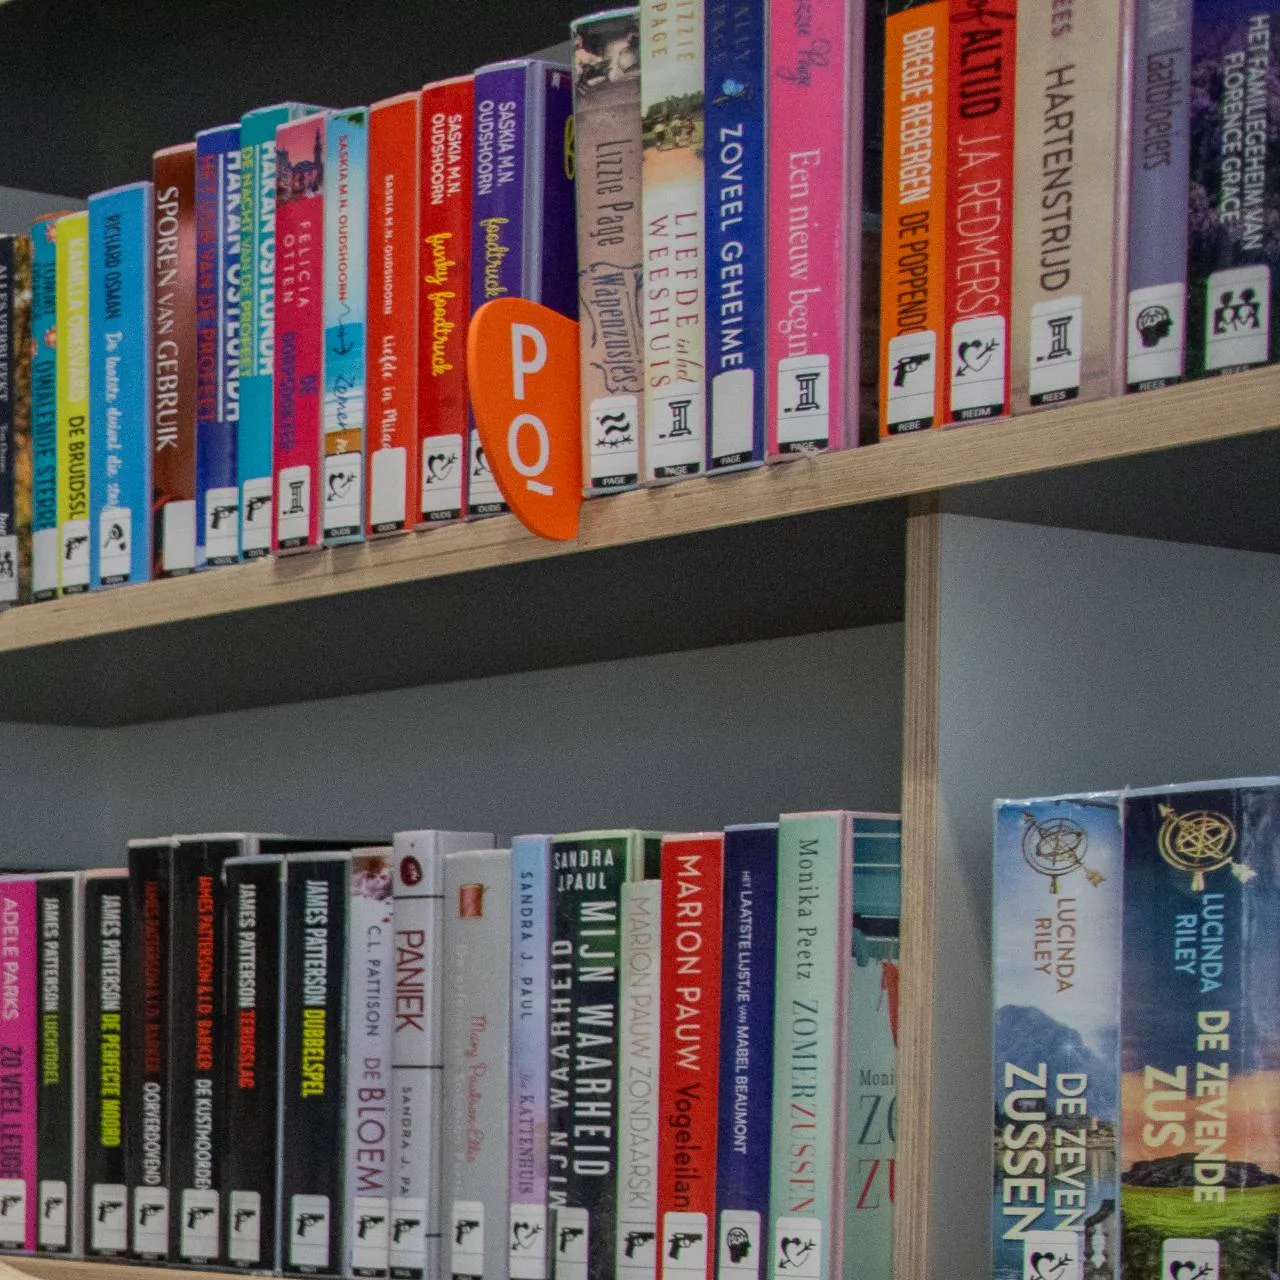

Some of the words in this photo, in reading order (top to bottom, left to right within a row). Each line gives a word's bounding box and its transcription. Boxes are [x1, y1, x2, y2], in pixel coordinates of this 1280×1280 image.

[901, 26, 934, 101] BREGJE
[959, 26, 1002, 120] ALTIJD
[1221, 51, 1245, 146] FLORENCE
[430, 113, 444, 205] OUDSHOORN
[446, 114, 462, 165] SASKIA
[478, 100, 494, 196] OUDSHOORN
[498, 102, 516, 156] SASKIA
[788, 149, 822, 197] Een
[898, 102, 934, 205] REBERGEN
[720, 124, 744, 231] ZOVEEL
[1040, 64, 1076, 292] HARTENSTRIJD
[1219, 148, 1241, 224] GRACE
[157, 186, 180, 288] SPOREN
[675, 211, 700, 329] LIEFDE
[786, 199, 819, 280] nieuw
[898, 211, 929, 238] DE
[157, 294, 176, 334] VAN
[648, 215, 670, 388] WEESHUIS
[155, 340, 179, 452] GEBRUIK
[553, 848, 614, 870] SANDRA
[798, 838, 818, 916] Monika
[579, 901, 615, 982] MIJN
[676, 854, 702, 977] MARION
[797, 926, 817, 979] Peetz
[1033, 917, 1053, 975] RILEY
[1056, 898, 1077, 993] LUCINDA
[1175, 914, 1197, 975] RILEY
[1199, 893, 1225, 994] LUCINDA
[395, 929, 425, 1033] PANIEK
[674, 988, 701, 1072] PAUW
[1197, 1010, 1230, 1052] DE
[573, 1004, 614, 1177] WAARHEID
[1056, 1072, 1088, 1113] DE
[1144, 1065, 1187, 1148] ZUS
[1194, 1062, 1229, 1204] ZEVENDE
[1002, 1062, 1048, 1241] ZUSSEN
[1054, 1130, 1087, 1232] ZEVEN
